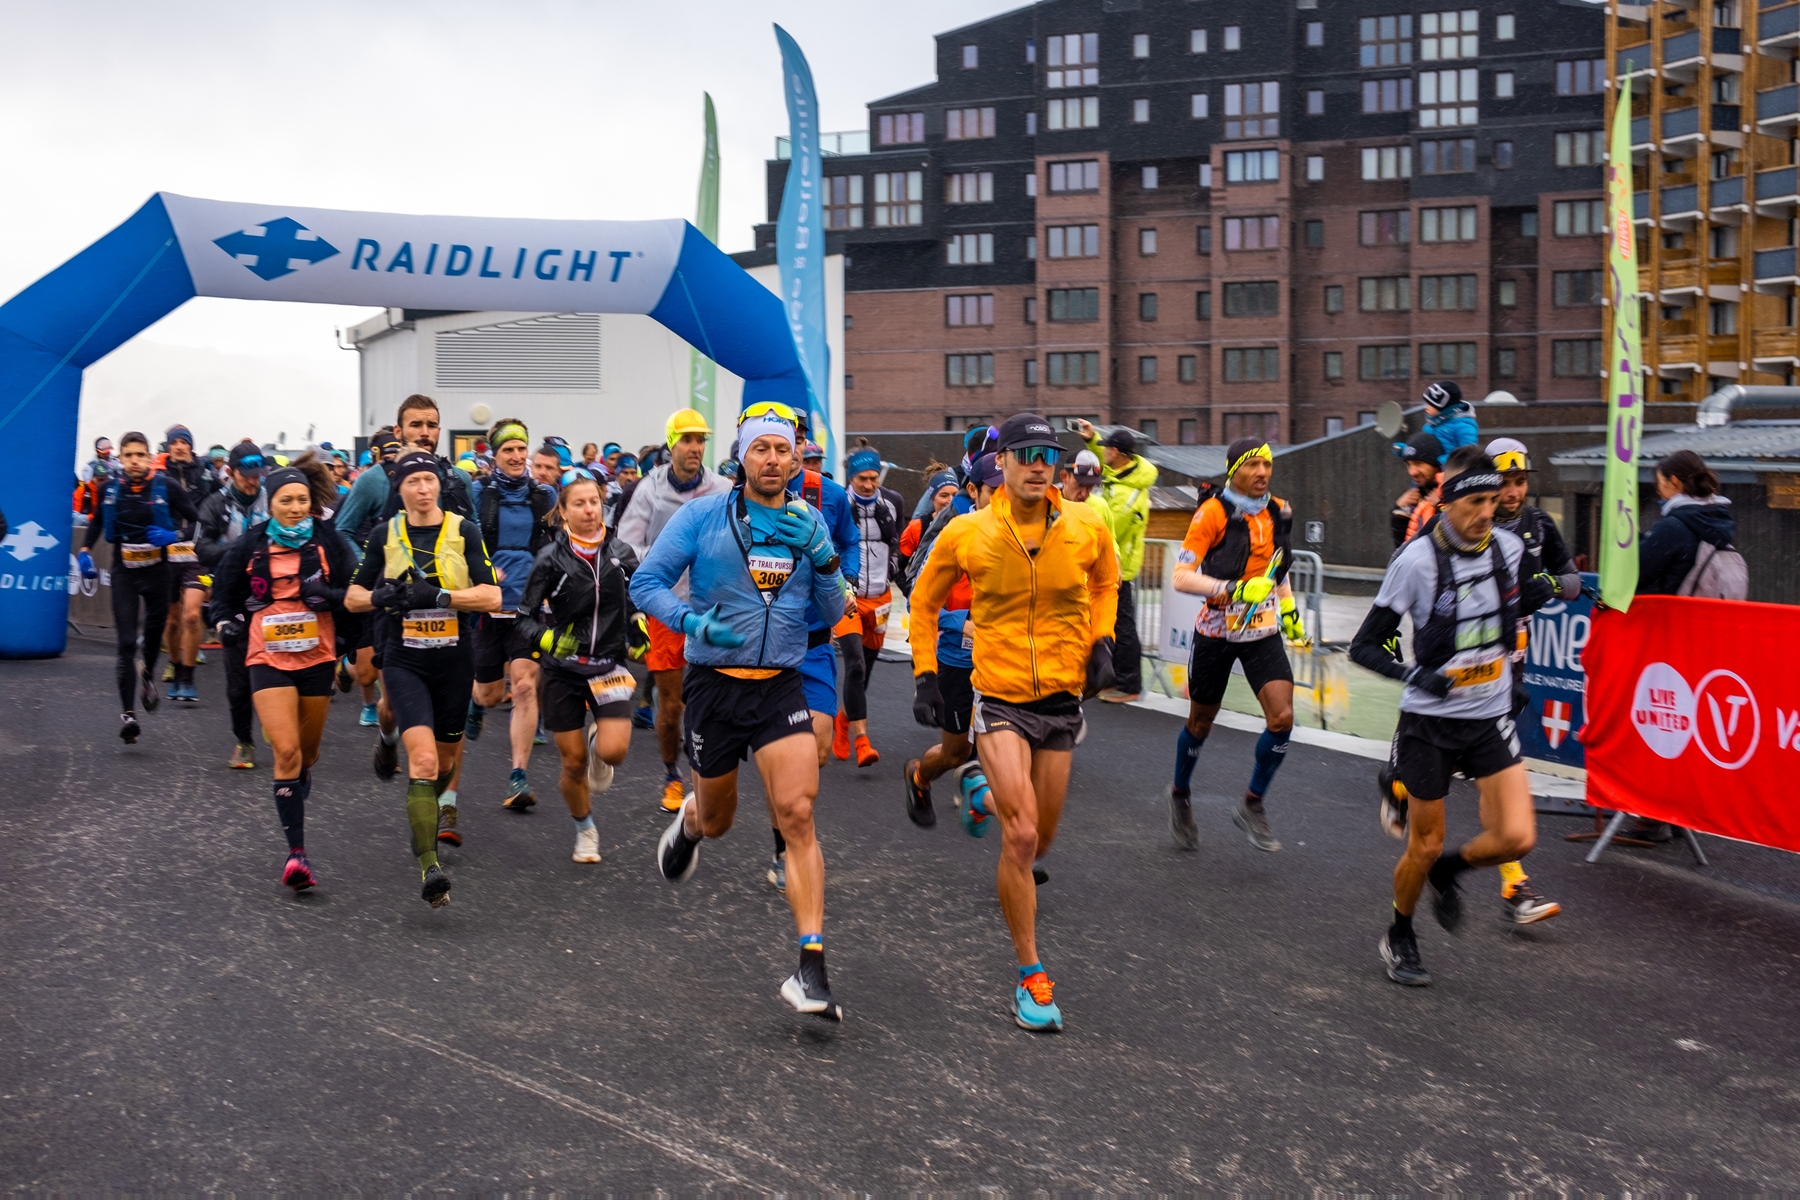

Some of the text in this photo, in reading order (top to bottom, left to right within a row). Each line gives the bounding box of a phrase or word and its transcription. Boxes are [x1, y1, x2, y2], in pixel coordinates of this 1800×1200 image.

[350, 238, 632, 283] RAIDLIGHT
[758, 560, 773, 571] TRAIL
[274, 623, 304, 636] 3064
[415, 620, 446, 632] 3102
[1649, 688, 1676, 708] LIVE
[1635, 709, 1690, 733] UNITED
